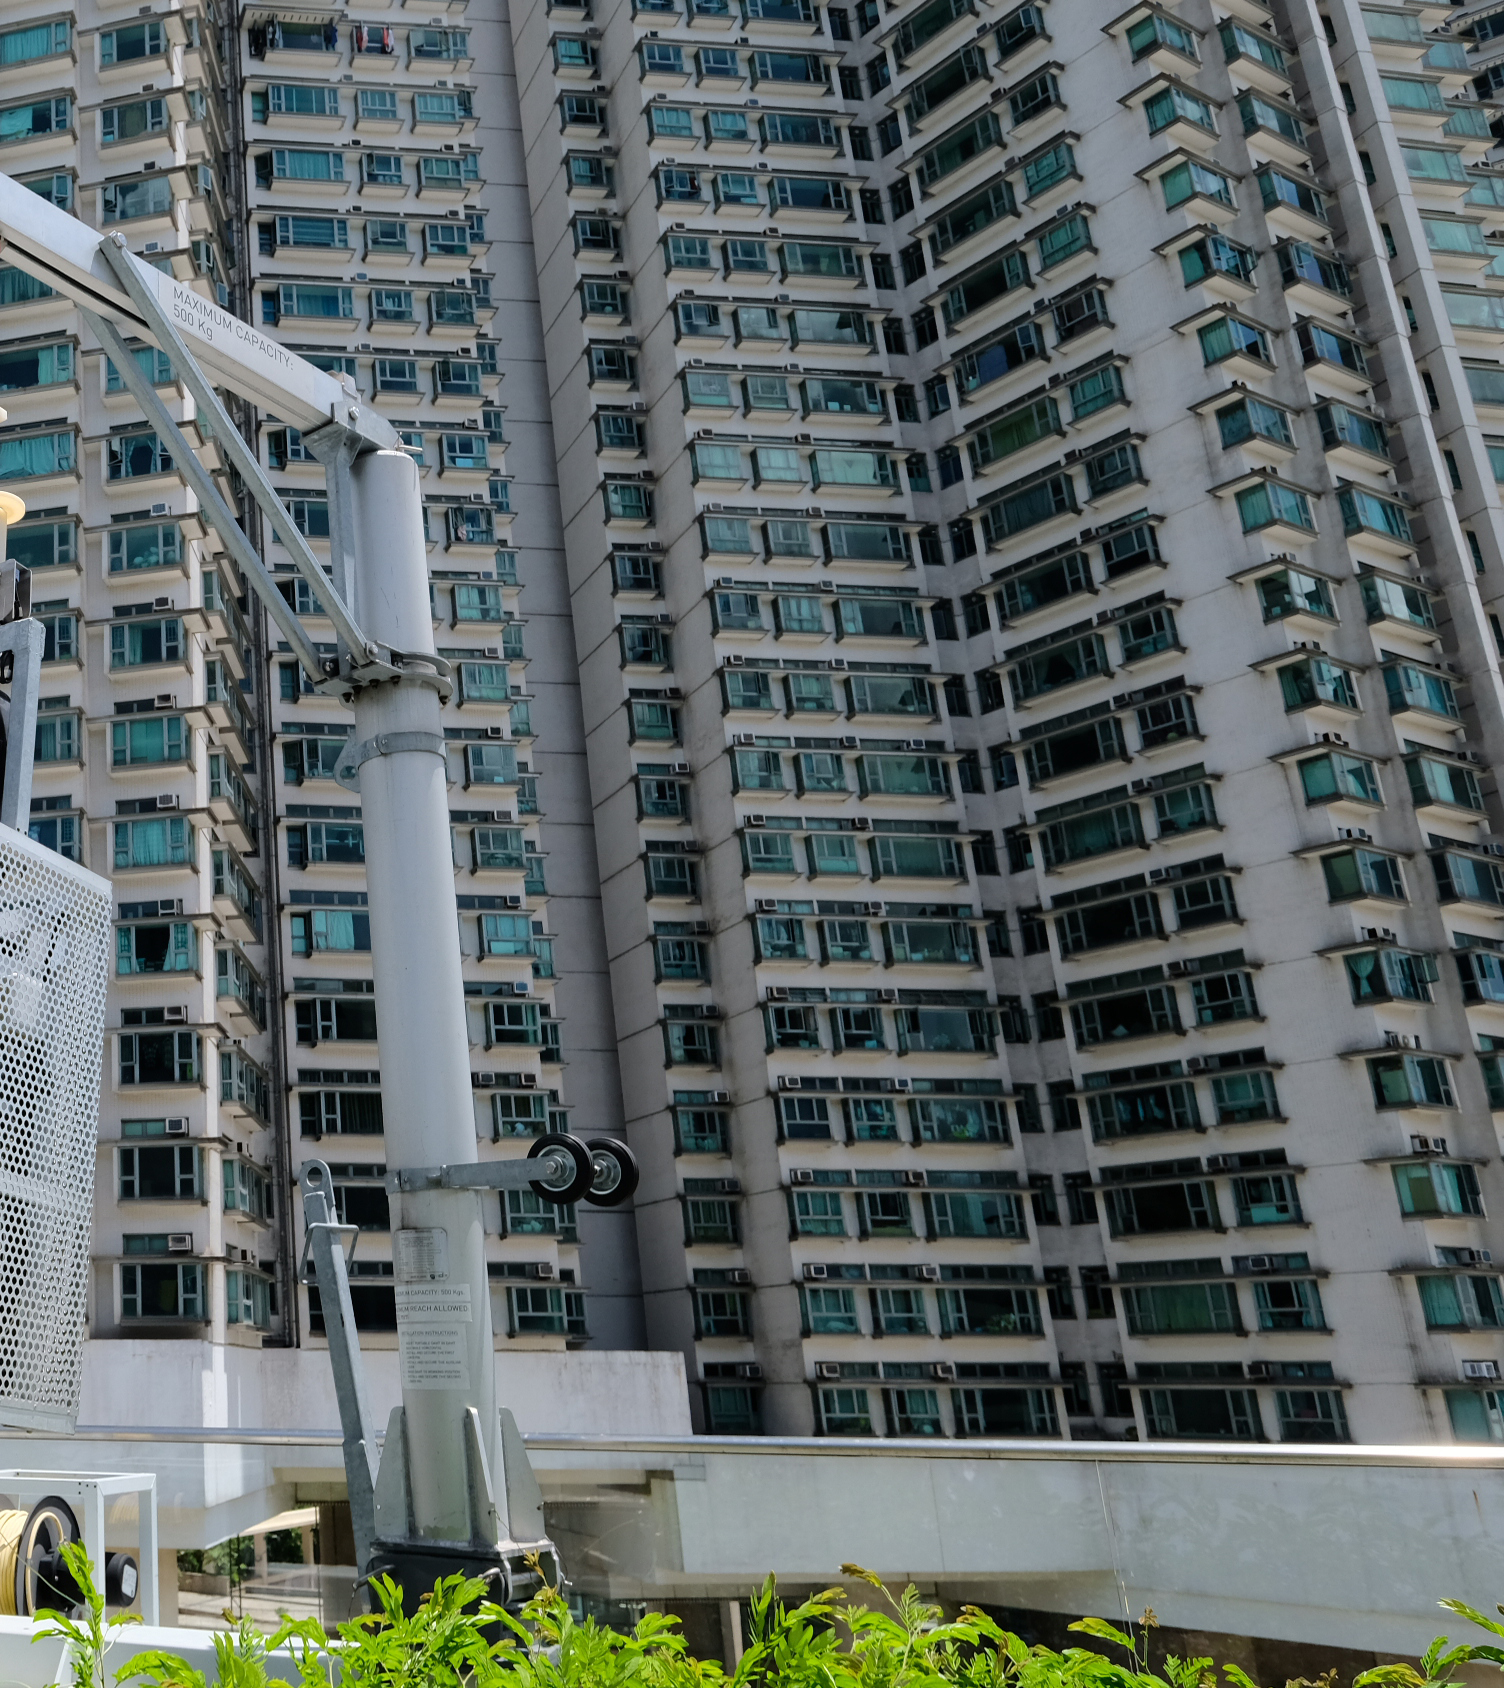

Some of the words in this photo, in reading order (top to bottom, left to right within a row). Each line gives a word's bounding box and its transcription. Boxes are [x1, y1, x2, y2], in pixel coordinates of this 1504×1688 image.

[173, 303, 194, 327] 500
[198, 318, 213, 342] Kg
[173, 286, 232, 333] MAXIMUM
[235, 325, 294, 371] CAPACITY:
